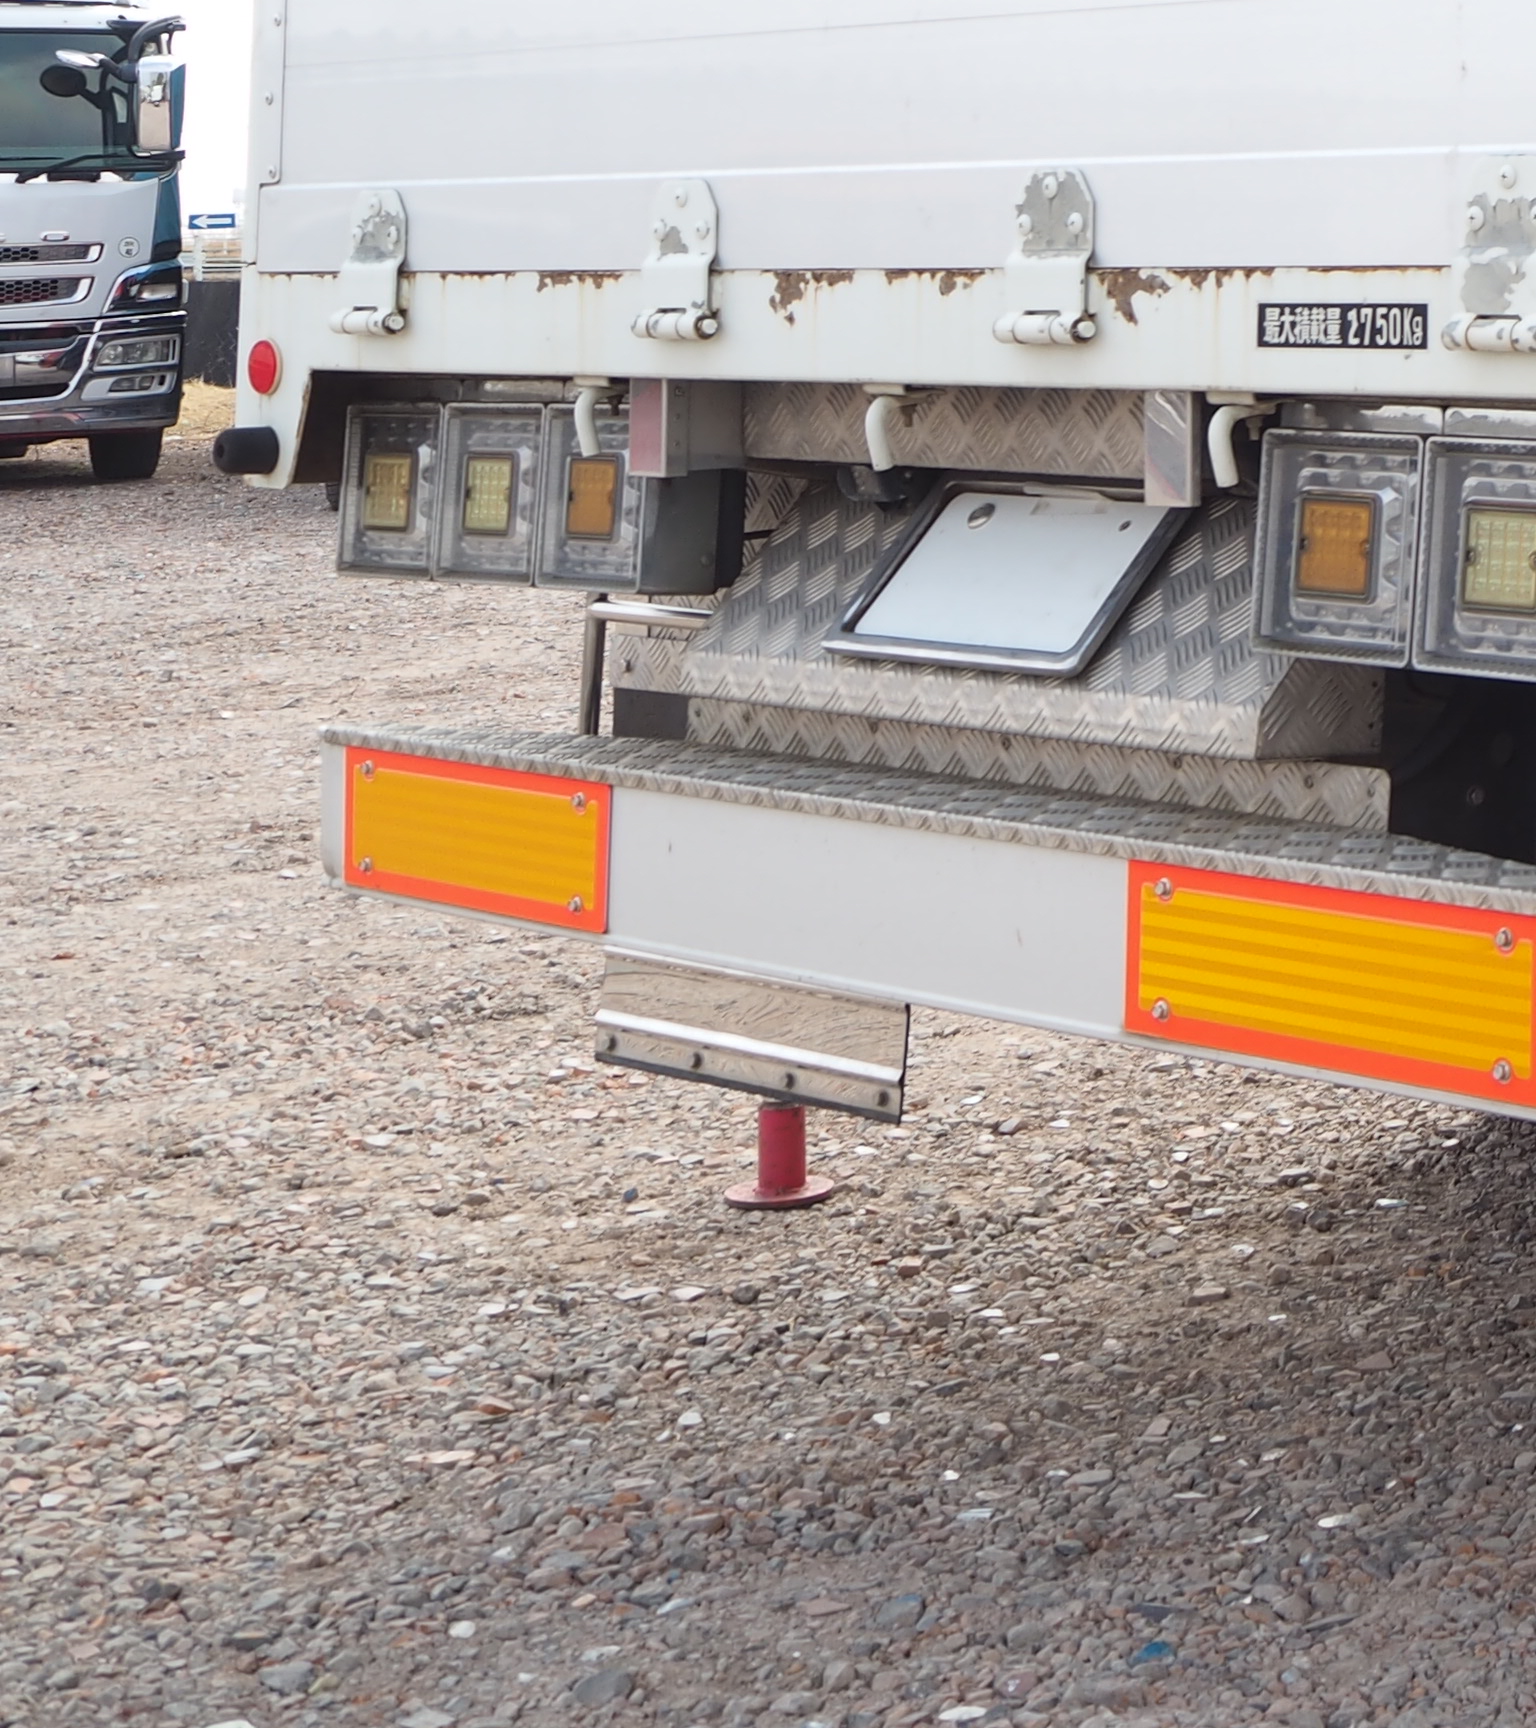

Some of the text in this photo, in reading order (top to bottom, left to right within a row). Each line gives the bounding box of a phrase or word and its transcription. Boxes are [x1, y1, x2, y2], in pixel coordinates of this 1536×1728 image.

[1263, 306, 1343, 345] 最大積載量
